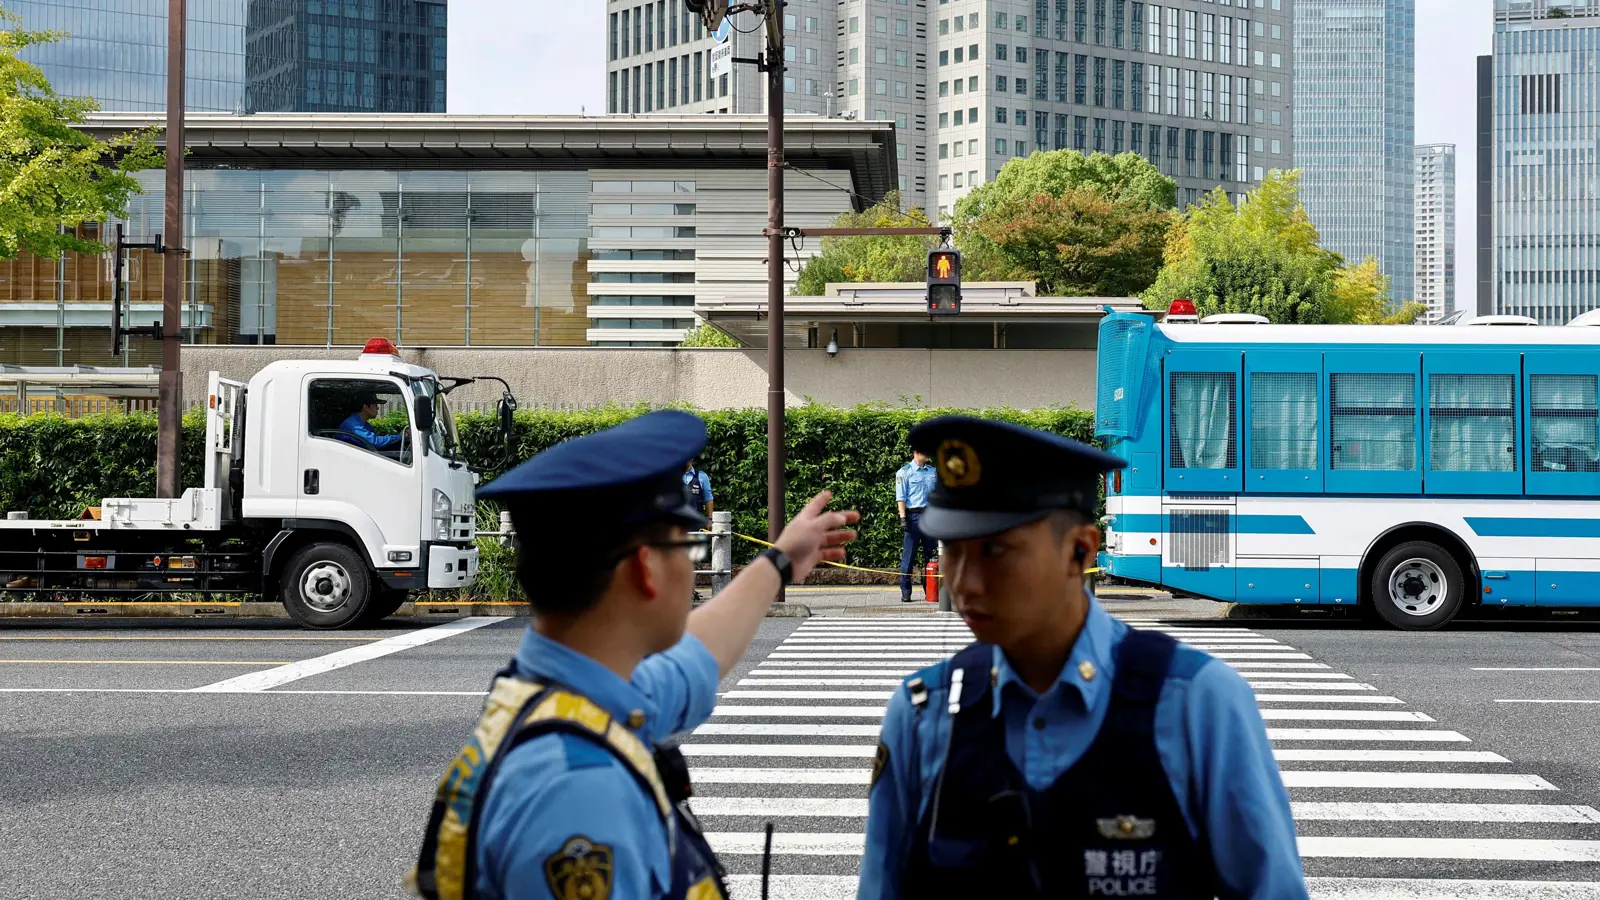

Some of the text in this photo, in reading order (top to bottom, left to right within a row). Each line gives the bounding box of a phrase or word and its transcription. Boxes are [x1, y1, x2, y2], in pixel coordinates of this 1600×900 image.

[1084, 849, 1161, 876] 警視庁
[1088, 877, 1157, 896] POLICE
